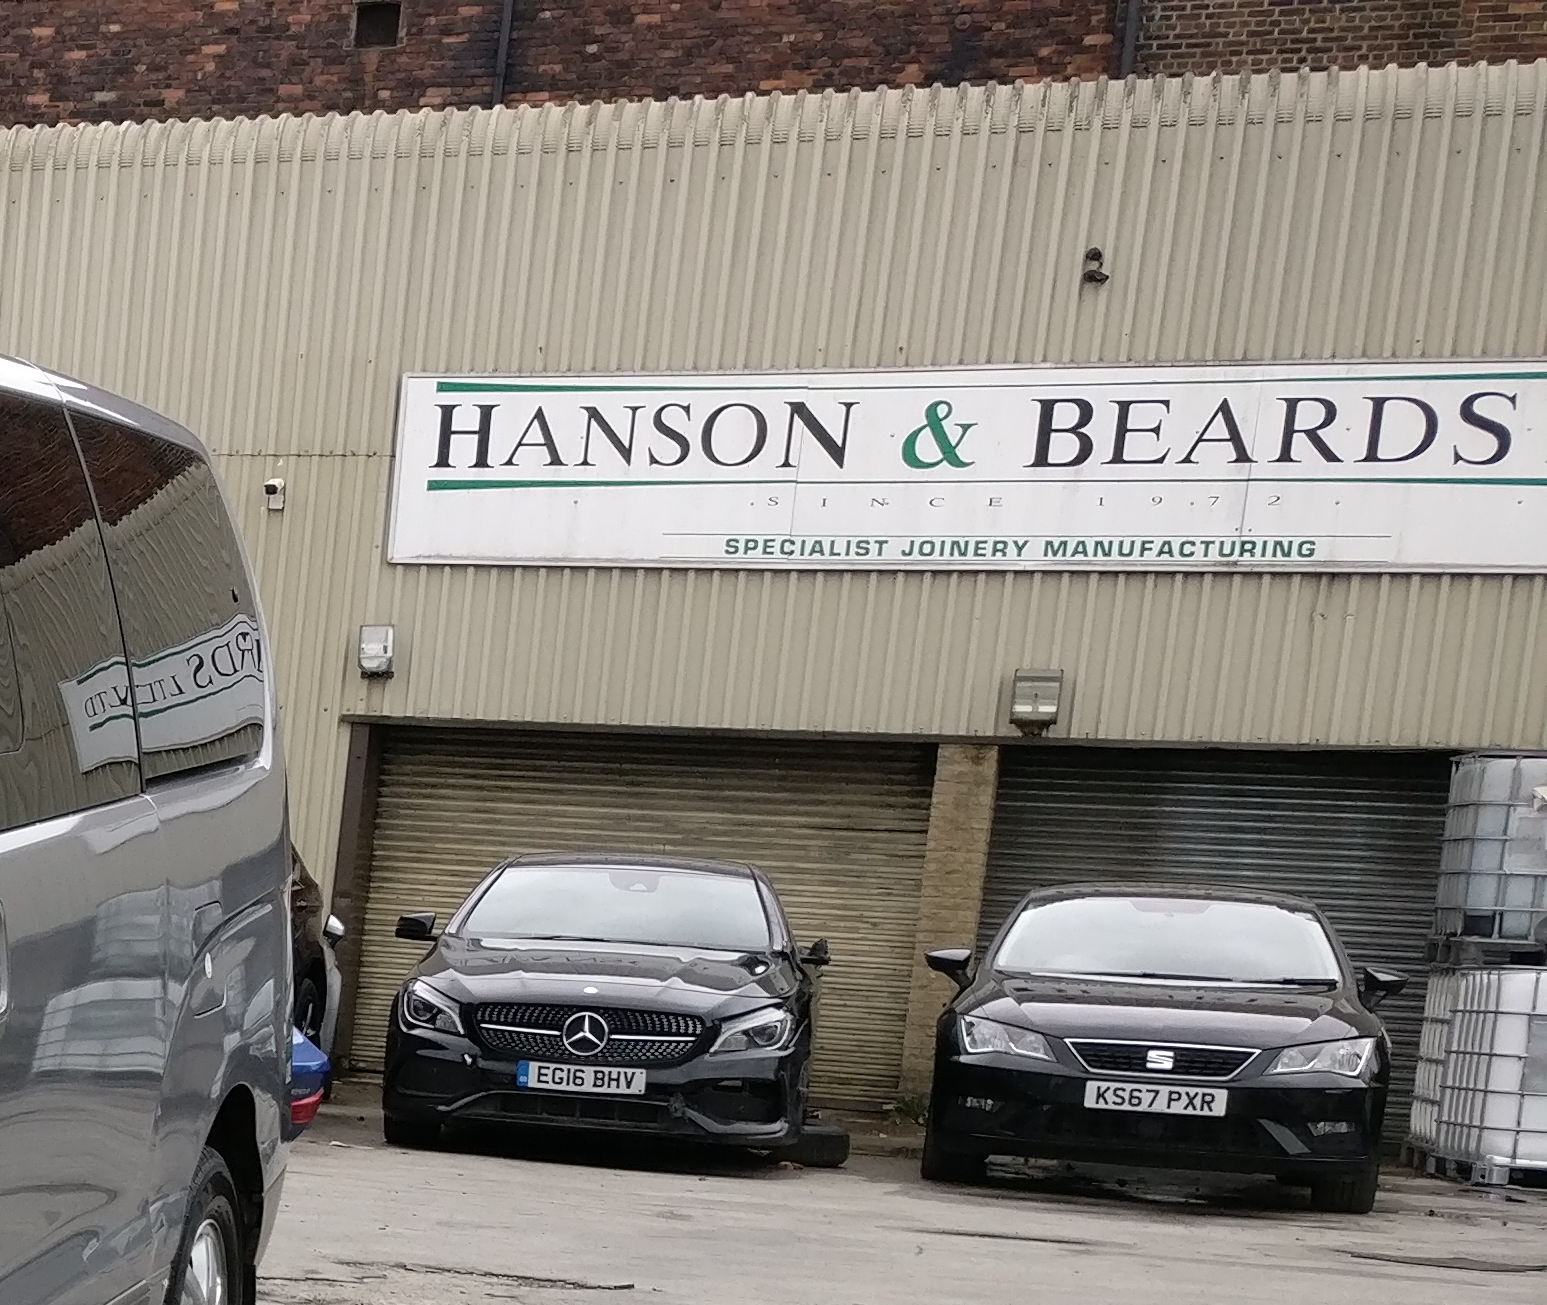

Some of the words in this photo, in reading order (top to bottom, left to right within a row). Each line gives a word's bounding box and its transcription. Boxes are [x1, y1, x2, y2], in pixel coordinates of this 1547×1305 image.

[428, 401, 861, 470] HANSON
[901, 400, 979, 470] &
[1022, 391, 1518, 469] BEARDS
[766, 495, 1004, 508] SINCE
[1096, 495, 1282, 508] 1972
[723, 537, 890, 558] SPECIALIST
[900, 537, 1030, 558] JOINERY
[1042, 538, 1318, 559] MANUFACTURING
[536, 1065, 586, 1087] EG16
[592, 1069, 637, 1090] BHV
[1095, 1085, 1160, 1109] KS67
[1166, 1089, 1216, 1112] PXR
